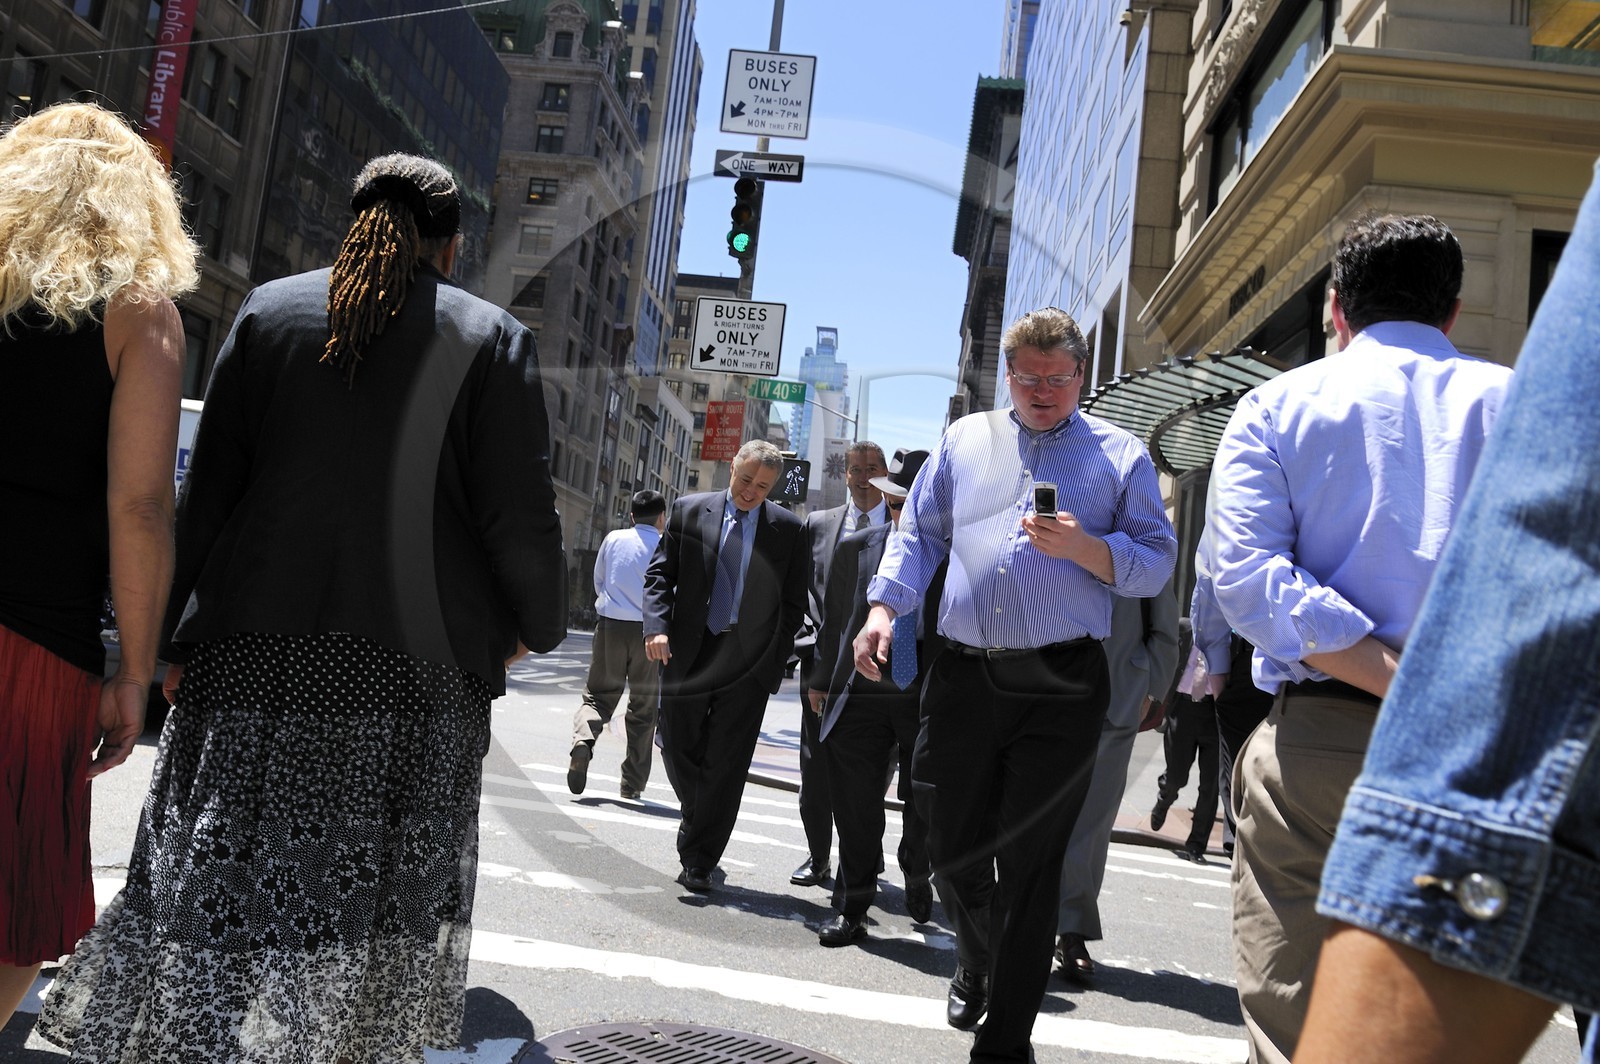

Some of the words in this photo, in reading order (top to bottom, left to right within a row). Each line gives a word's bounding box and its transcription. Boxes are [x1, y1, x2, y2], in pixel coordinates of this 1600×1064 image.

[745, 58, 798, 75] BUSES
[145, 50, 176, 128] Library
[748, 76, 791, 92] ONLY
[753, 95, 802, 107] 7AM-10AM
[753, 107, 799, 119] 4PM-7PM
[747, 119, 766, 128] MON
[769, 122, 785, 130] THRU
[787, 122, 802, 131] FRI
[732, 158, 756, 171] ONE
[768, 161, 794, 174] WAY
[714, 304, 767, 321] BUSES
[721, 321, 741, 329] RIGHT
[743, 323, 765, 331] TURNS
[716, 330, 759, 346] ONLY
[727, 346, 770, 358] 7AM-7PM
[720, 358, 738, 367] MON
[741, 361, 757, 369] THRU
[760, 360, 774, 370] FRI
[760, 380, 771, 398] W
[772, 382, 790, 400] 40
[791, 384, 803, 394] ST
[726, 404, 744, 414] ROUTE
[706, 427, 714, 437] NO
[715, 427, 740, 437] STANDING
